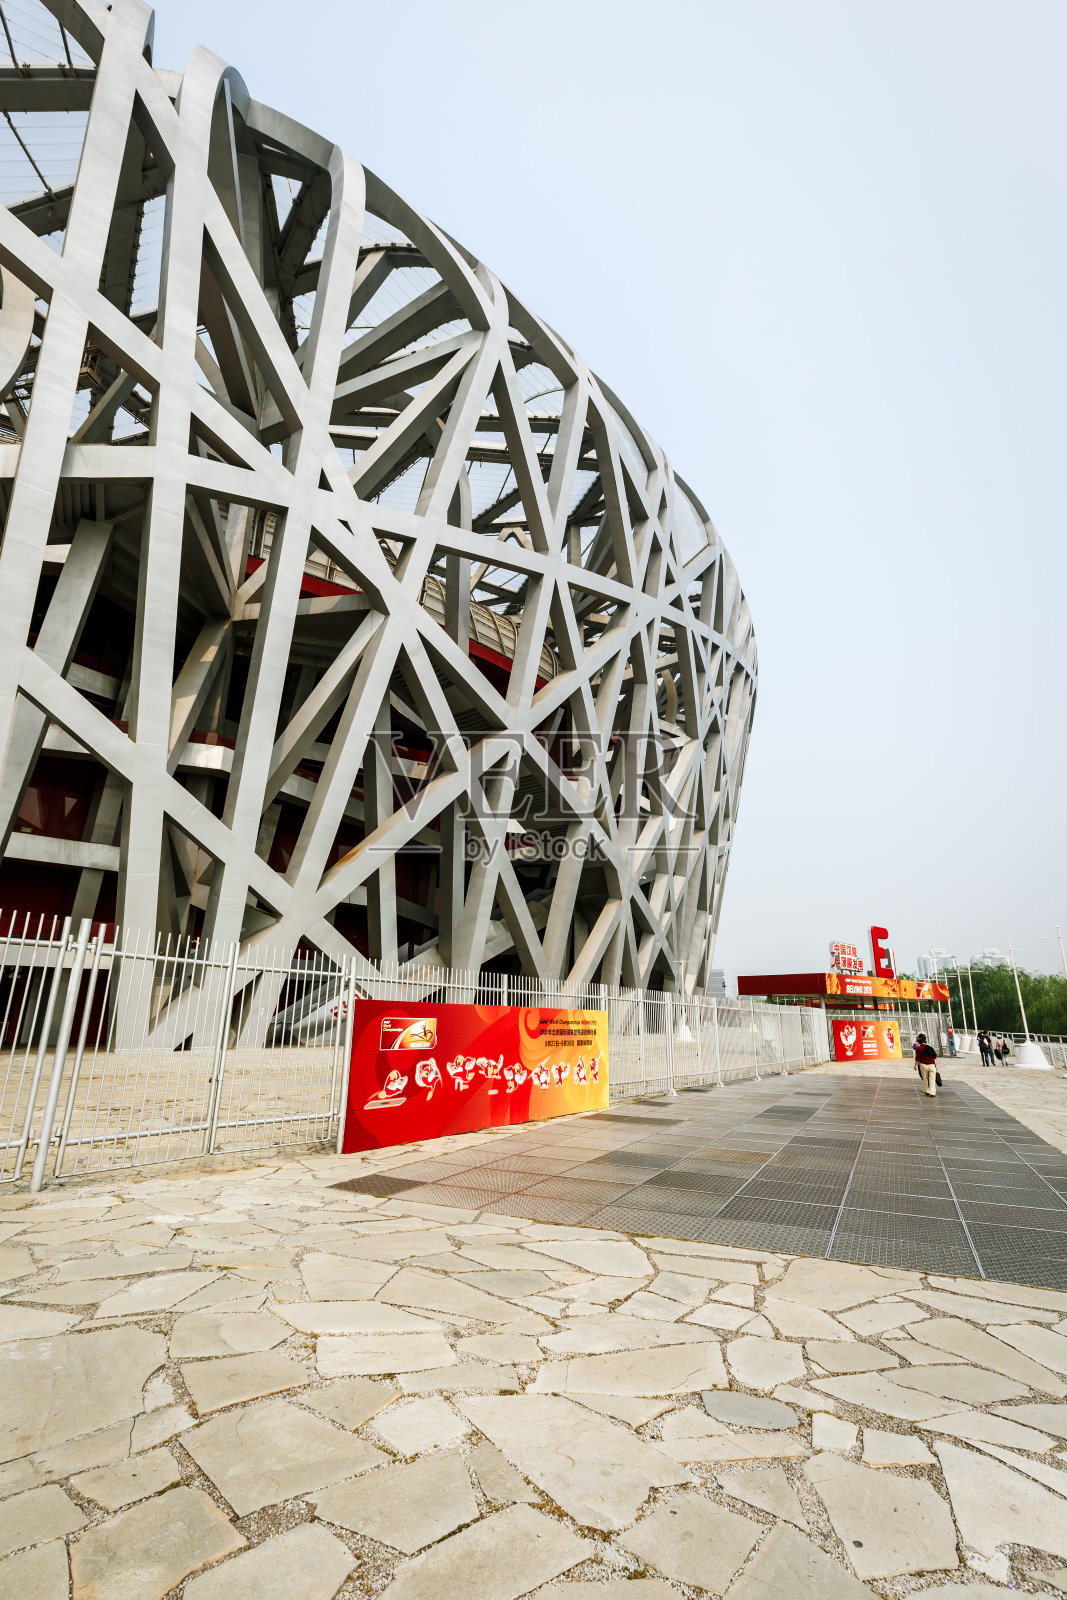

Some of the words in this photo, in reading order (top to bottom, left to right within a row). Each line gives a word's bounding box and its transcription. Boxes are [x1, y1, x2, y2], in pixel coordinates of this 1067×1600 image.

[833, 942, 857, 957] 中国汉能
[870, 926, 894, 979] E
[846, 985, 863, 994] BEIJING
